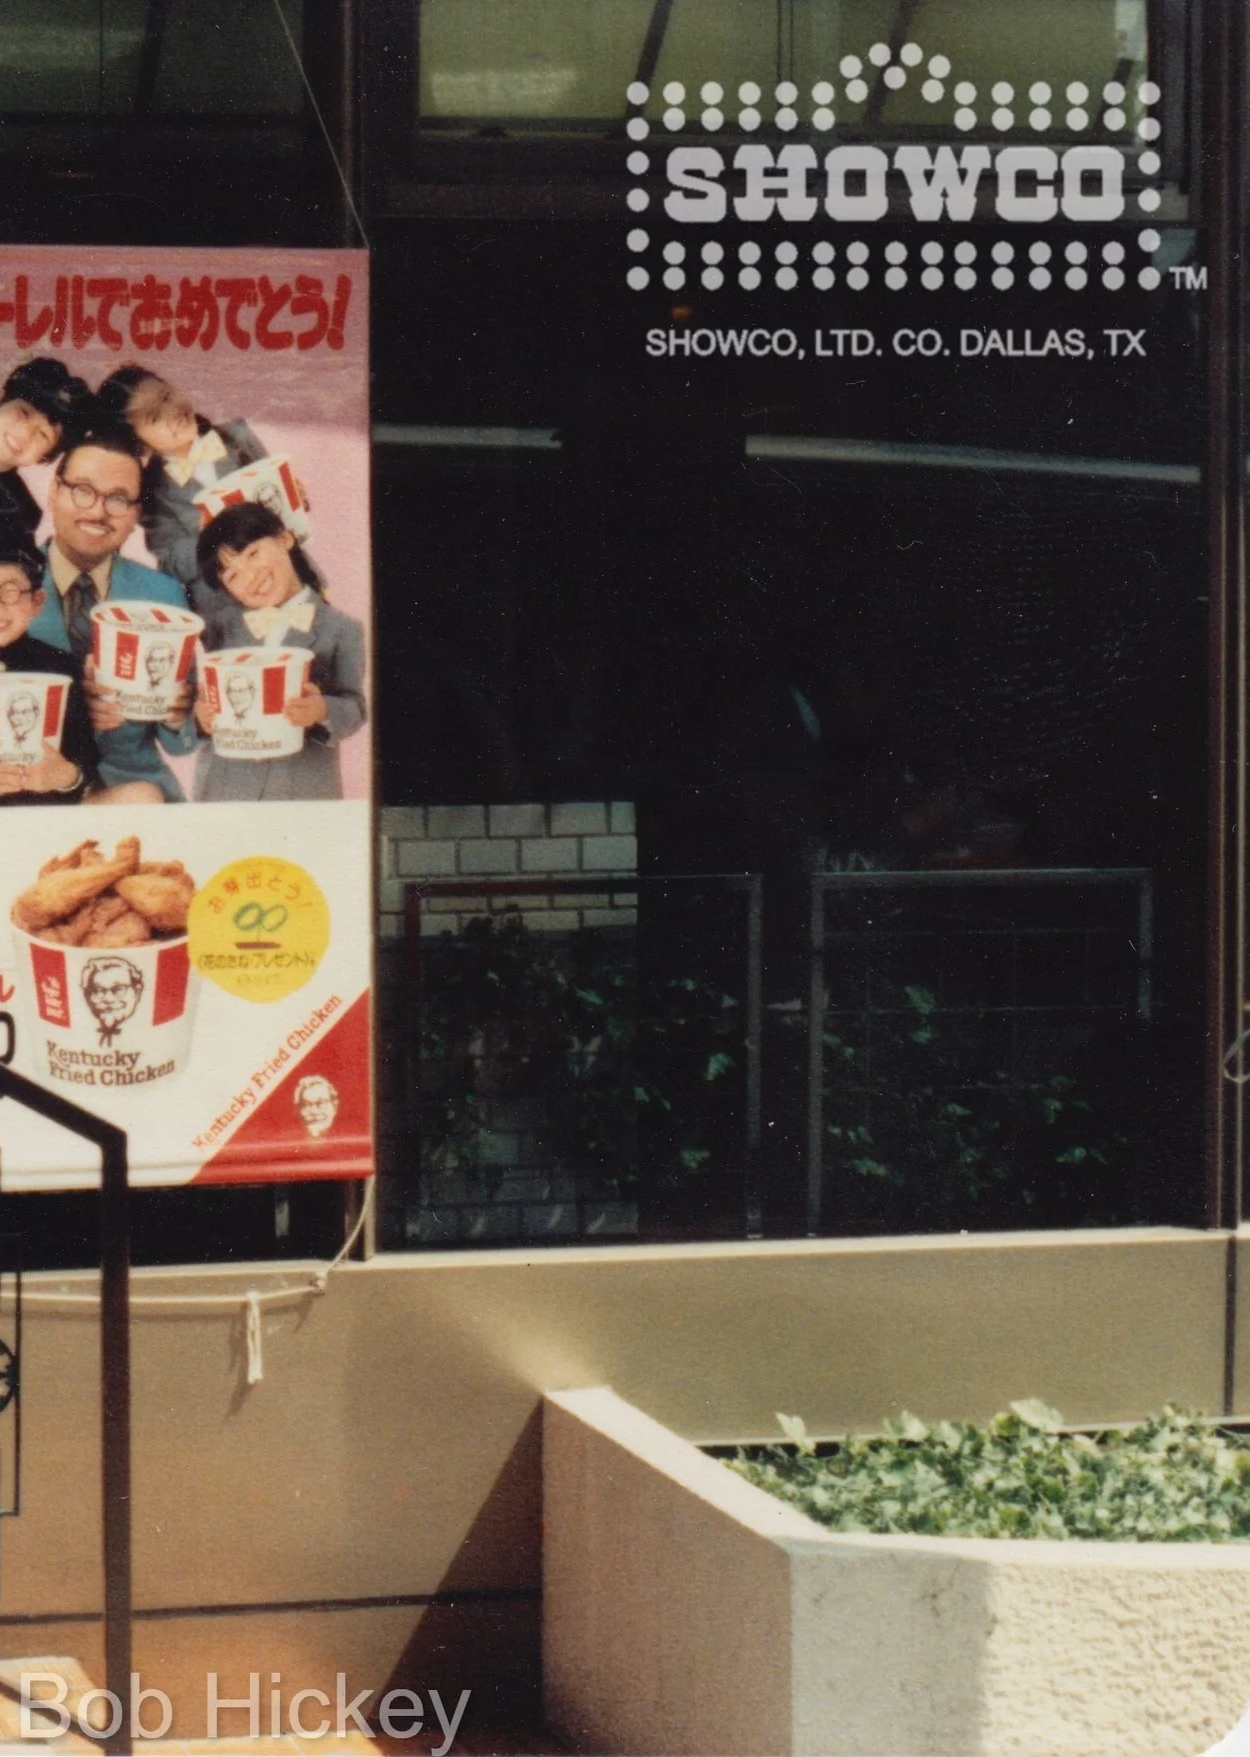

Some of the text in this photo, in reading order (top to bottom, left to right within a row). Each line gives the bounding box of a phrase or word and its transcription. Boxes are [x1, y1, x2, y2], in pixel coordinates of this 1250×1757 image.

[46, 1039, 141, 1071] Kentucky
[49, 1059, 175, 1086] Fried Chicken
[192, 1087, 257, 1149] Kentucky
[250, 1047, 291, 1089] Fried
[286, 995, 343, 1050] Chicken
